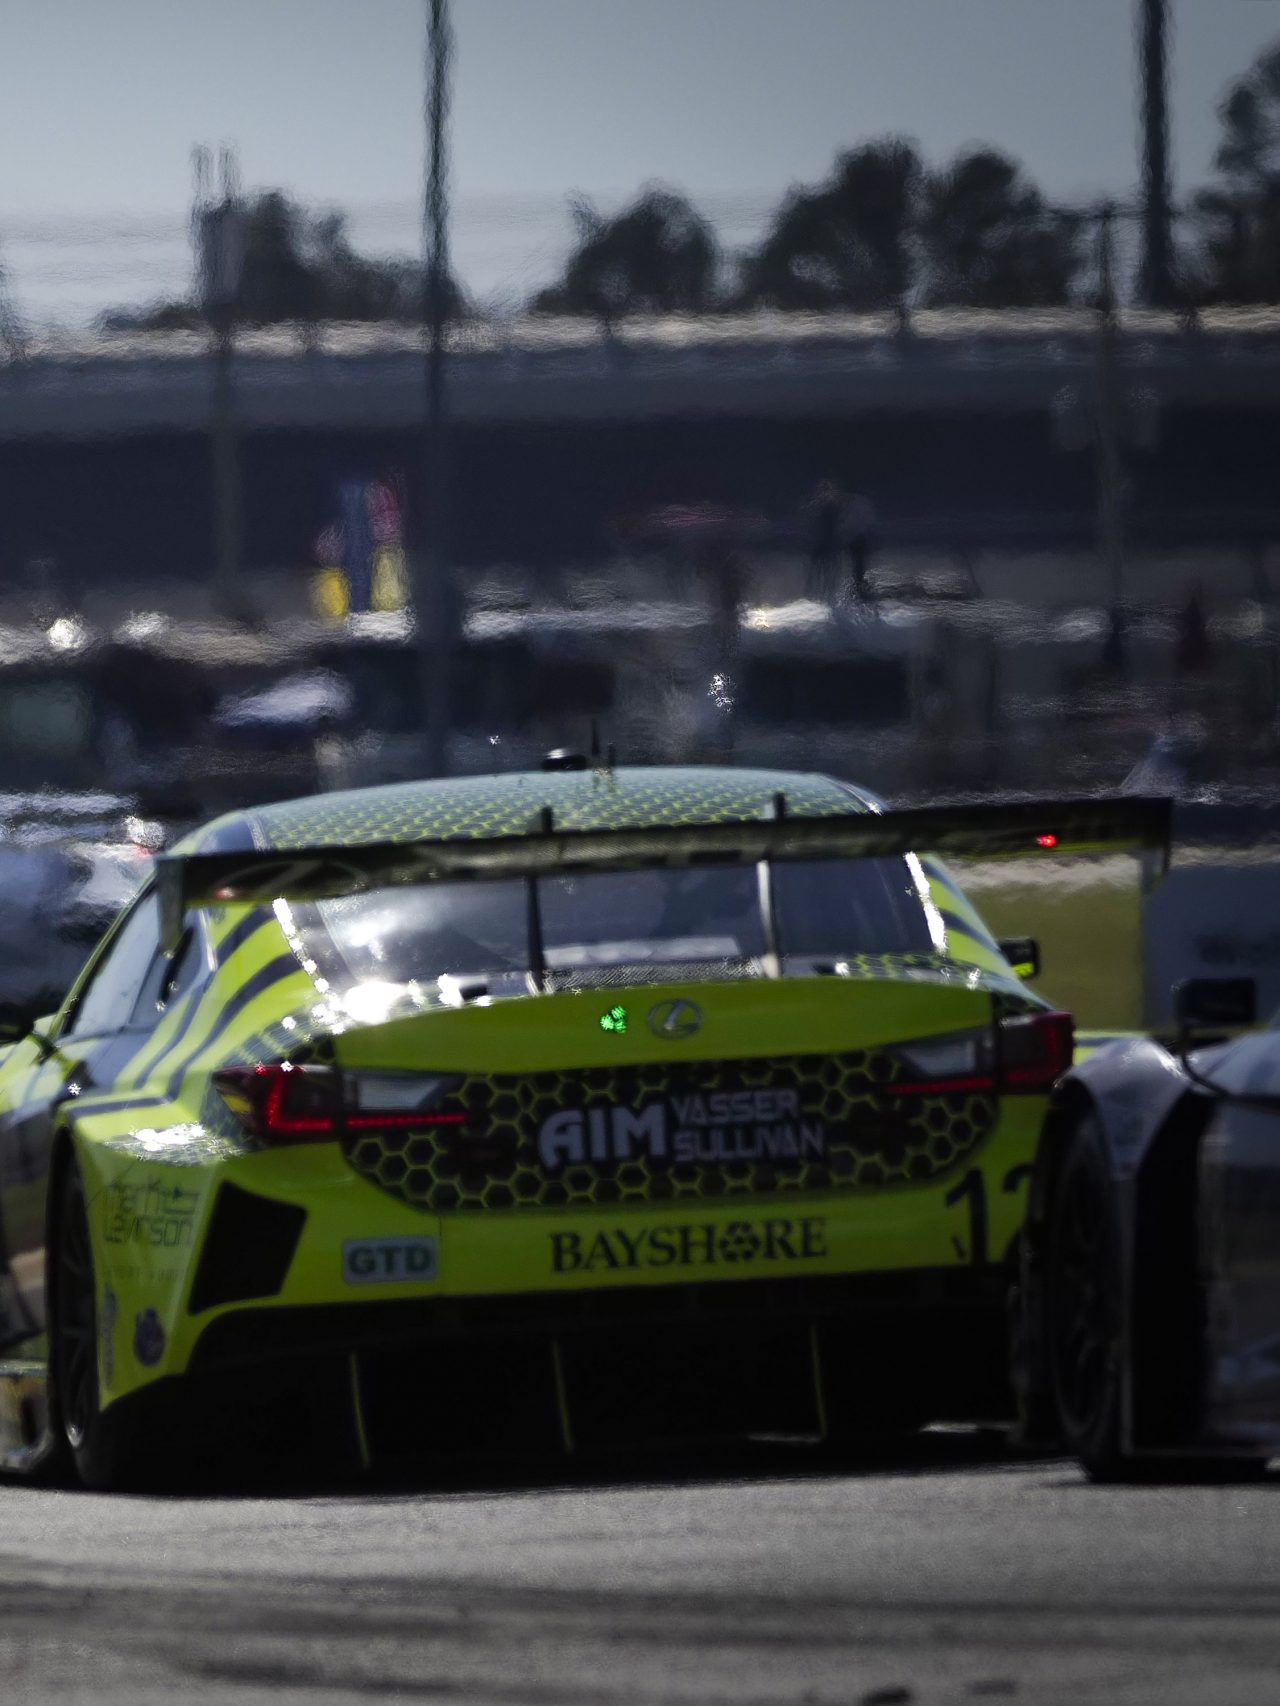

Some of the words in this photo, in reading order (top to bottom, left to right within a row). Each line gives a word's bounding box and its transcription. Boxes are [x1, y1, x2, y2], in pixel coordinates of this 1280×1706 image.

[537, 1103, 667, 1170] AIM
[671, 1087, 799, 1127] VASSER
[672, 1119, 825, 1163] SULLIVAN
[349, 1246, 433, 1275] GTD
[549, 1216, 827, 1274] BAYSHORE
